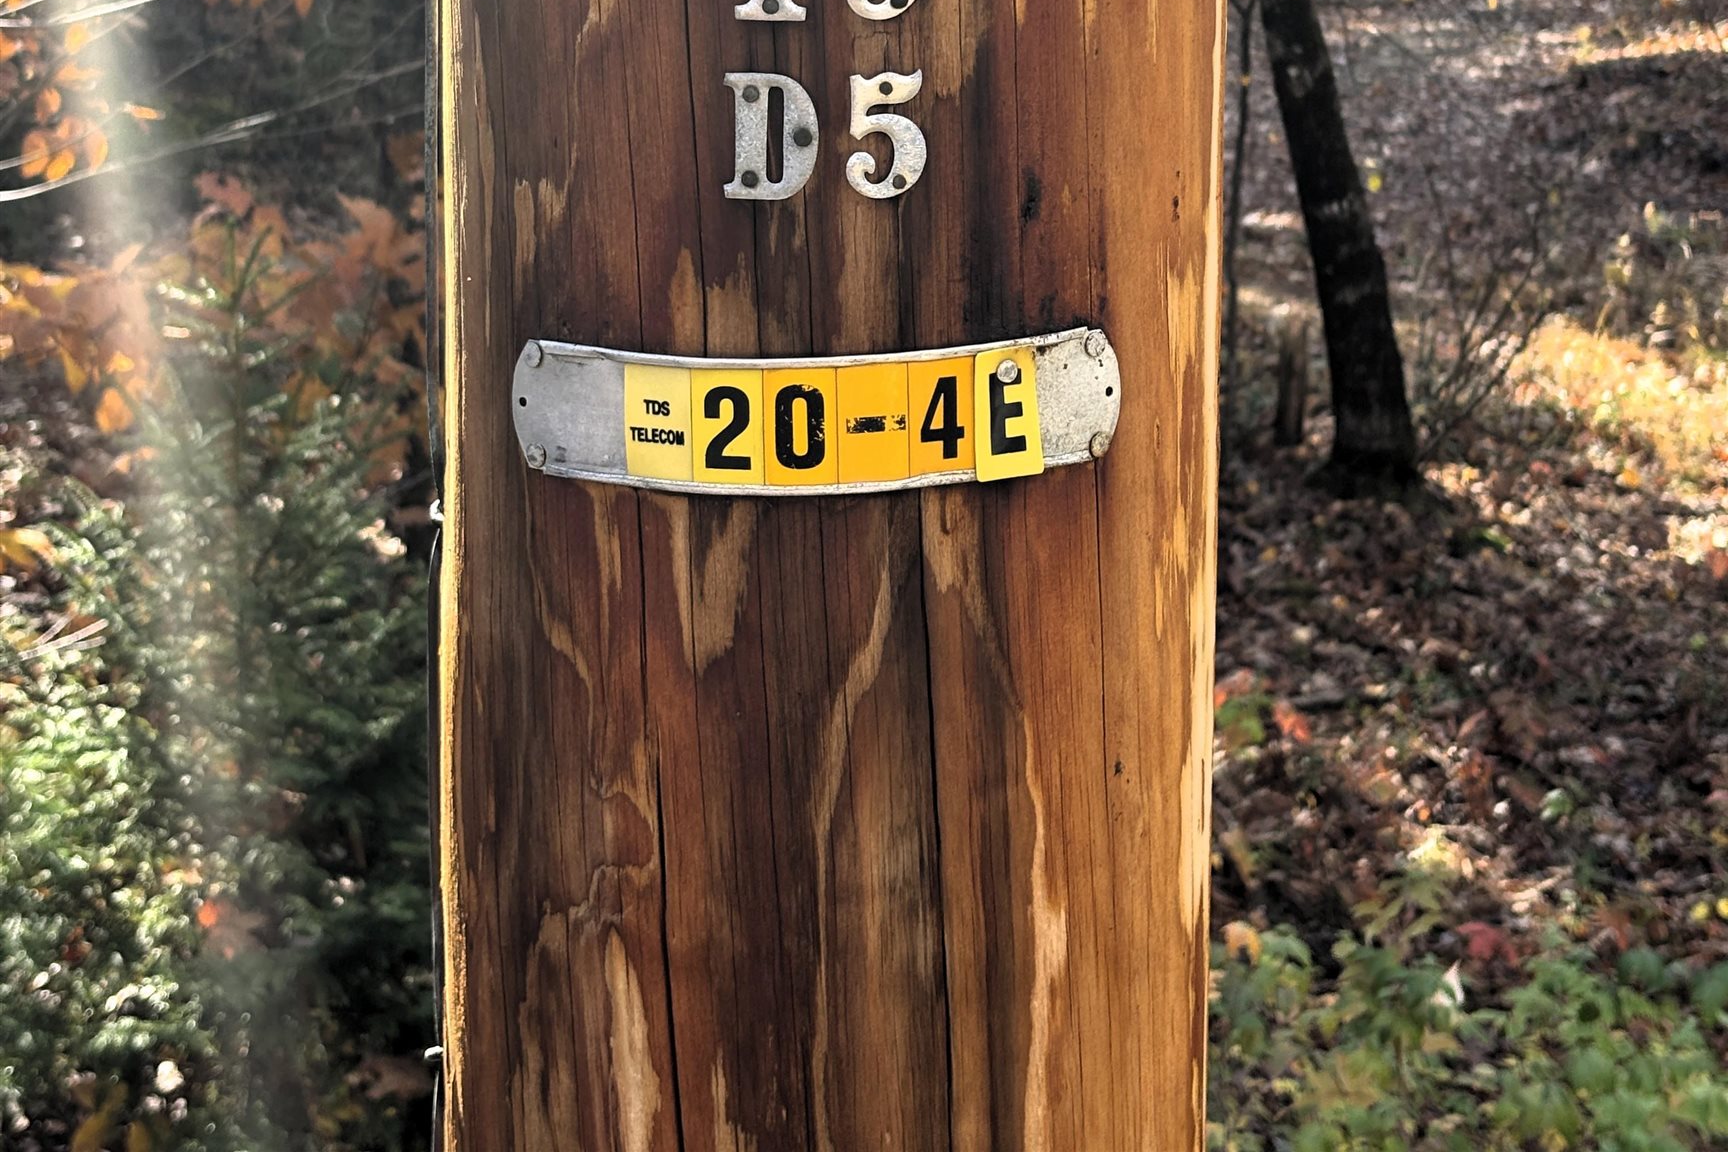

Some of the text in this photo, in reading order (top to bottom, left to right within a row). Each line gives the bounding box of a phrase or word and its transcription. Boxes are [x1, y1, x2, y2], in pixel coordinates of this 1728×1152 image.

[723, 68, 927, 199] D5
[643, 398, 671, 417] TDS
[629, 425, 685, 446] TELECOM
